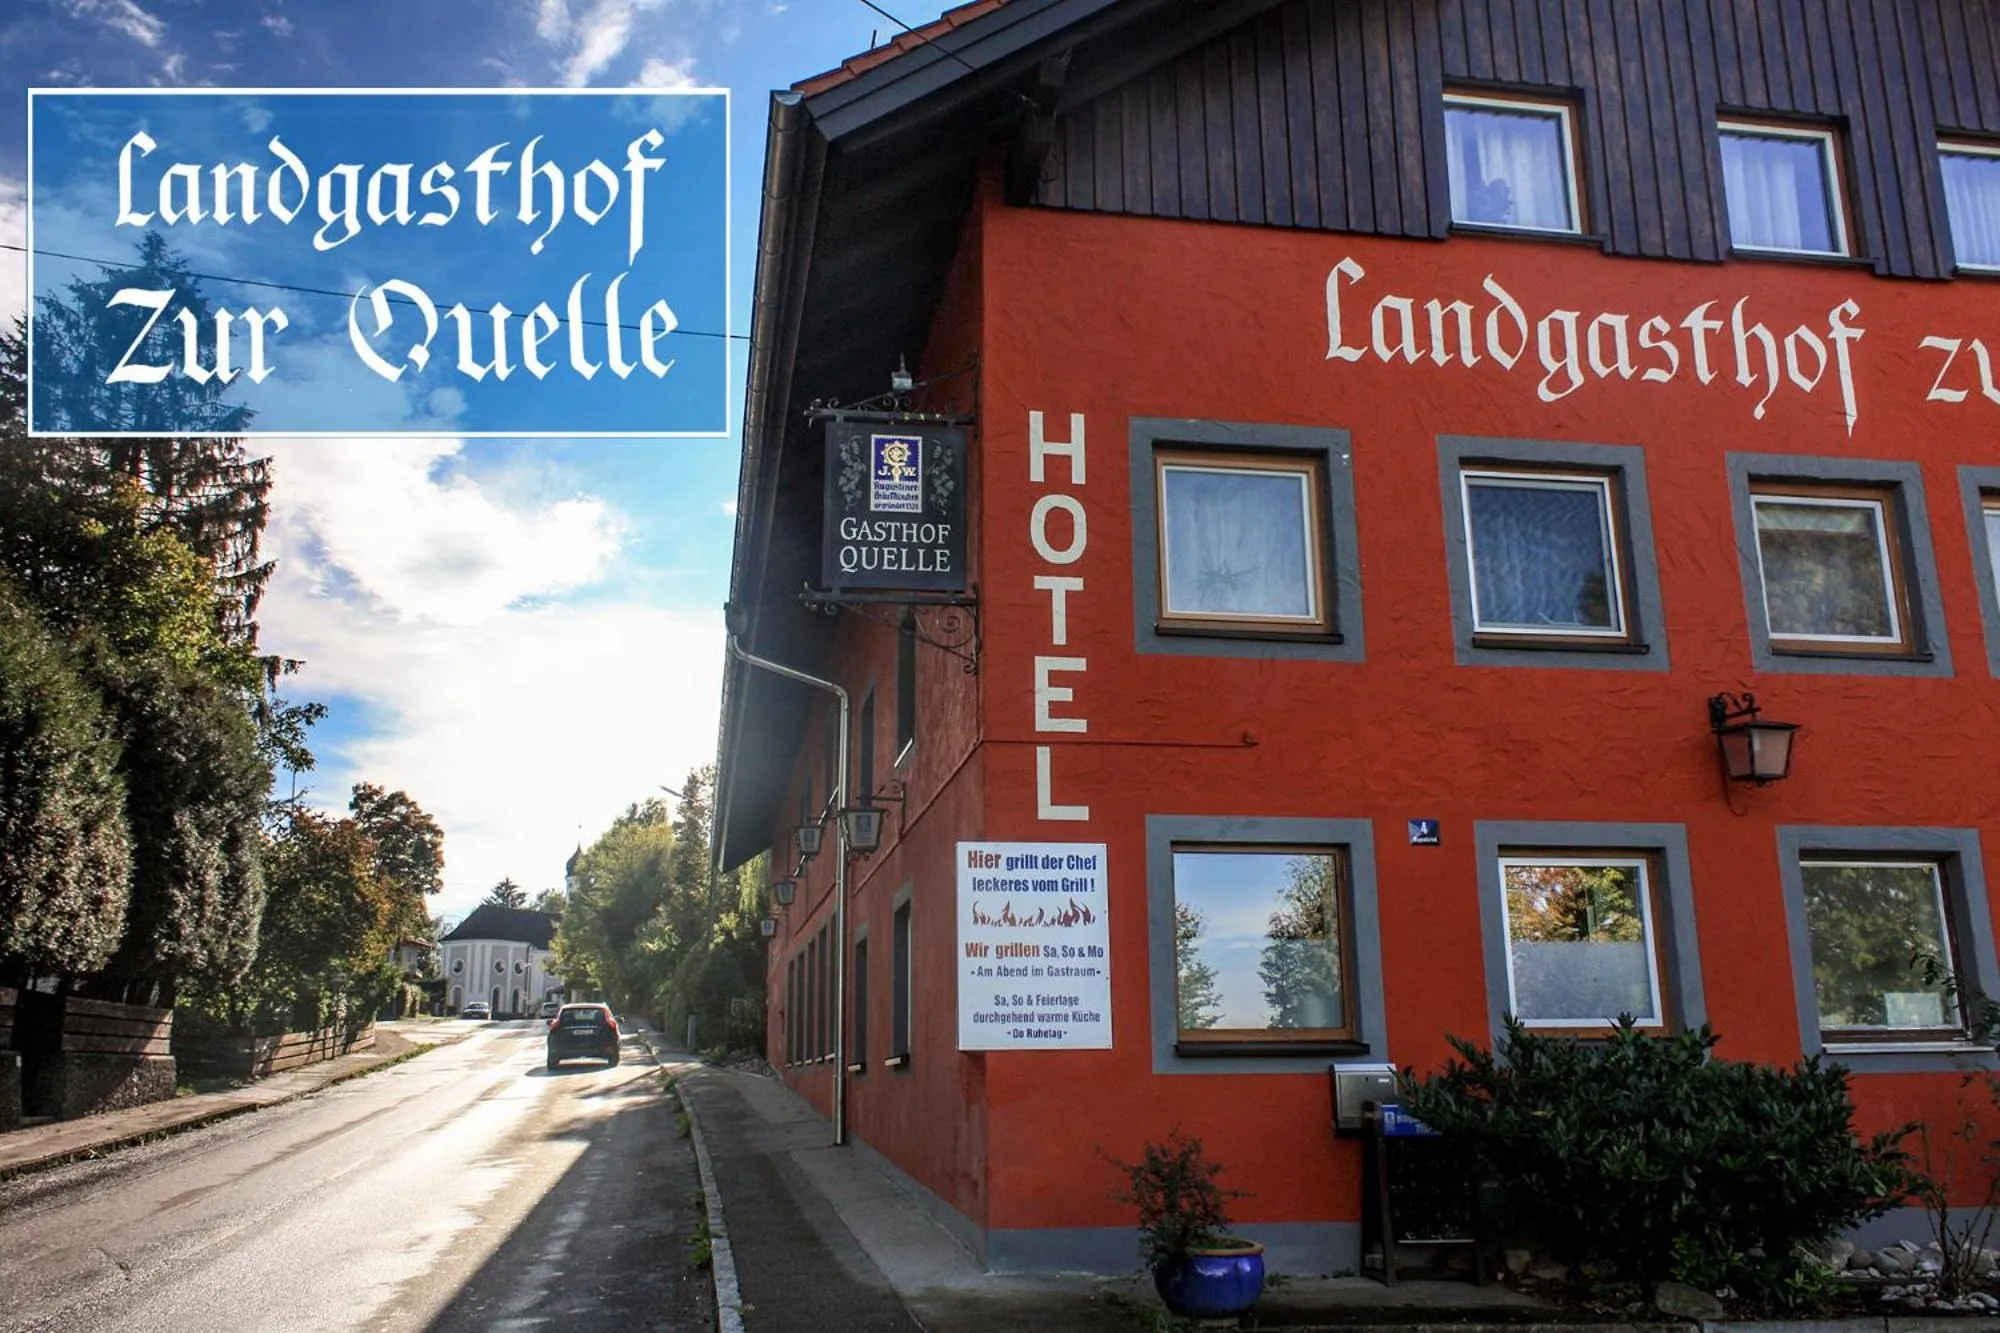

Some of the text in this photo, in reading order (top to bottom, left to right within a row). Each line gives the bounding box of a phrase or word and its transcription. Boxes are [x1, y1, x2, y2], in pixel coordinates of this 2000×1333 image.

[1325, 256, 1865, 438] Landgasthof
[839, 545, 951, 573] QUELLE
[1029, 410, 1090, 821] HOTEL
[967, 850, 1097, 871] Hier grillt der Chef
[972, 877, 1029, 892] leckeres
[1031, 878, 1058, 892] vom
[965, 942, 989, 958] Wir
[995, 942, 1040, 959] grillen
[1061, 945, 1075, 958] So
[1078, 946, 1085, 958] &
[1087, 946, 1104, 958] Mo
[996, 966, 1028, 977] Abend
[1031, 966, 1044, 977] im
[1035, 995, 1080, 1007] Feiertage
[973, 1011, 1101, 1024] durchgehend warme Küche
[1026, 1028, 1063, 1039] Ruhetag
